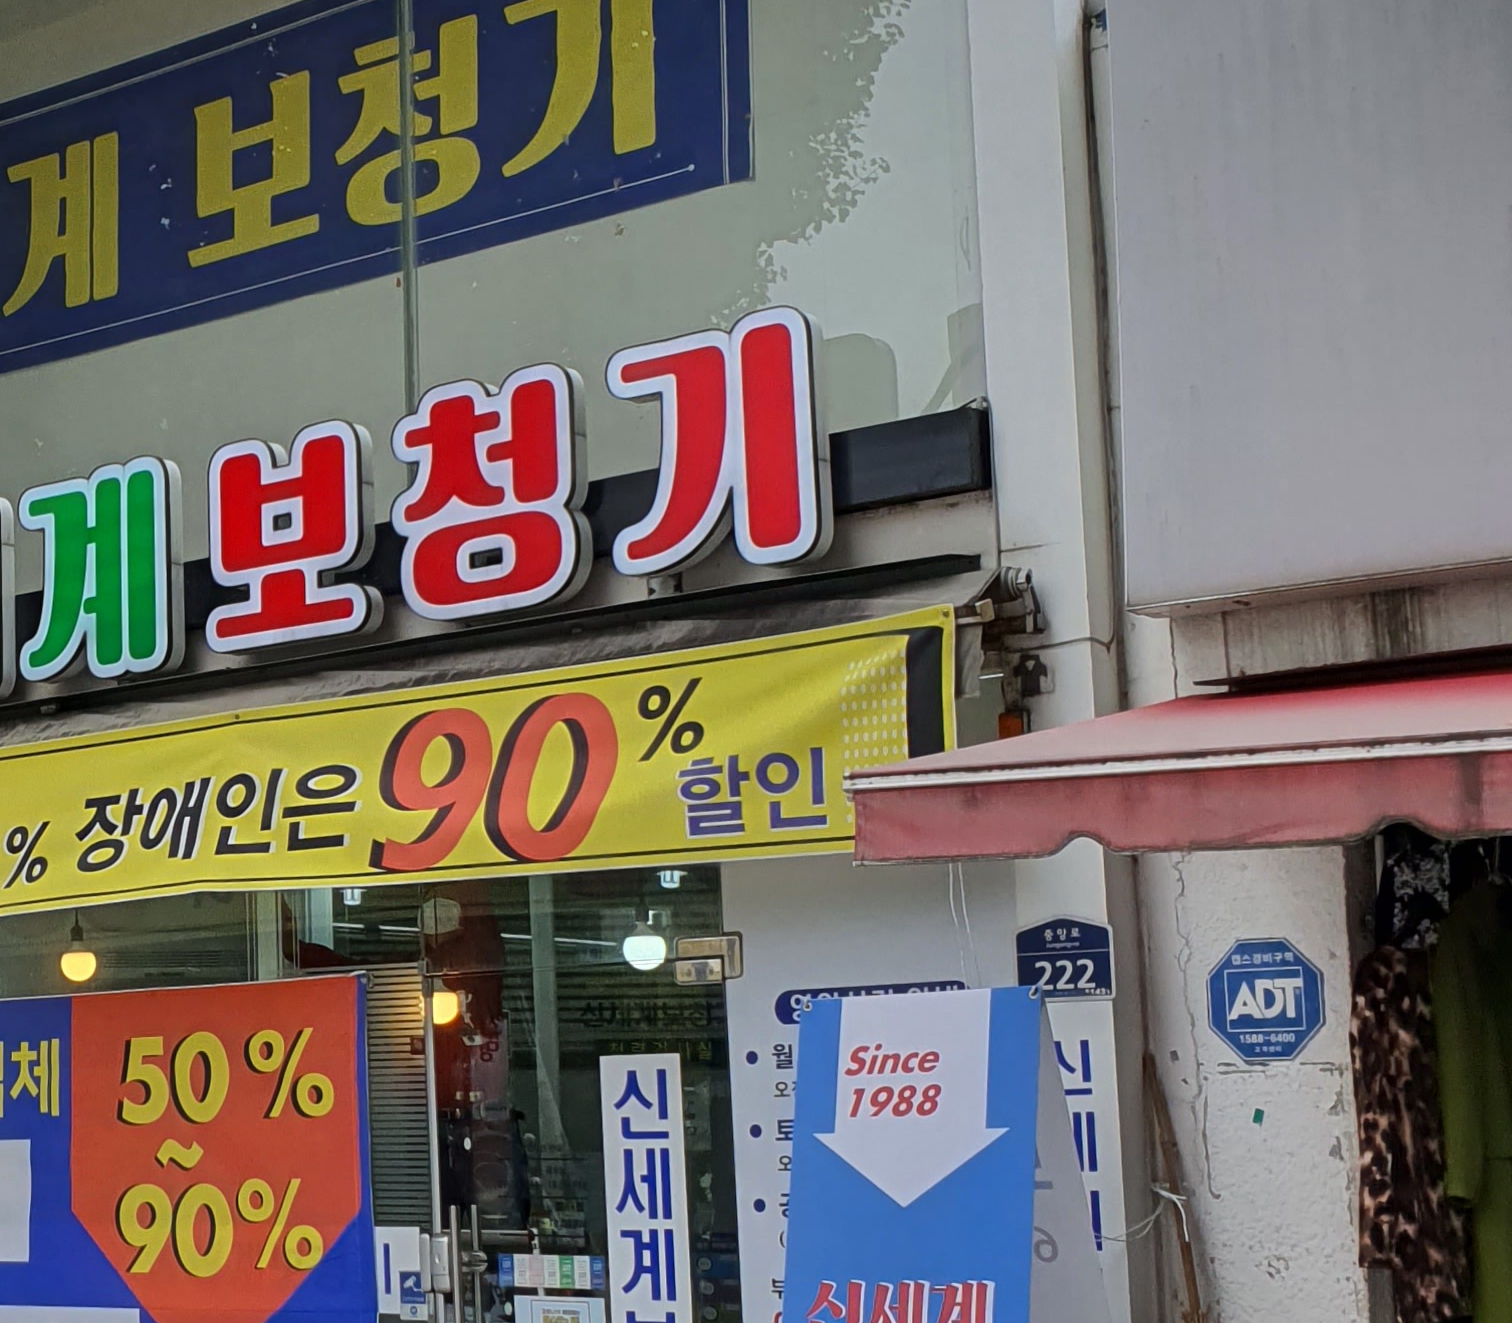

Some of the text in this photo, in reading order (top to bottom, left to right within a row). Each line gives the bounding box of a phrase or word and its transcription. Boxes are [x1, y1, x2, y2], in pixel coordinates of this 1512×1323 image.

[206, 305, 818, 653] 보청기
[75, 763, 359, 873] 장애인은
[675, 746, 828, 839] 할인
[1034, 959, 1096, 990] 222
[1229, 978, 1302, 1020] ADT
[1239, 1033, 1295, 1043] 1588-6400
[844, 1043, 940, 1077] Since
[849, 1084, 942, 1117] 1988
[117, 1178, 324, 1277] 90%
